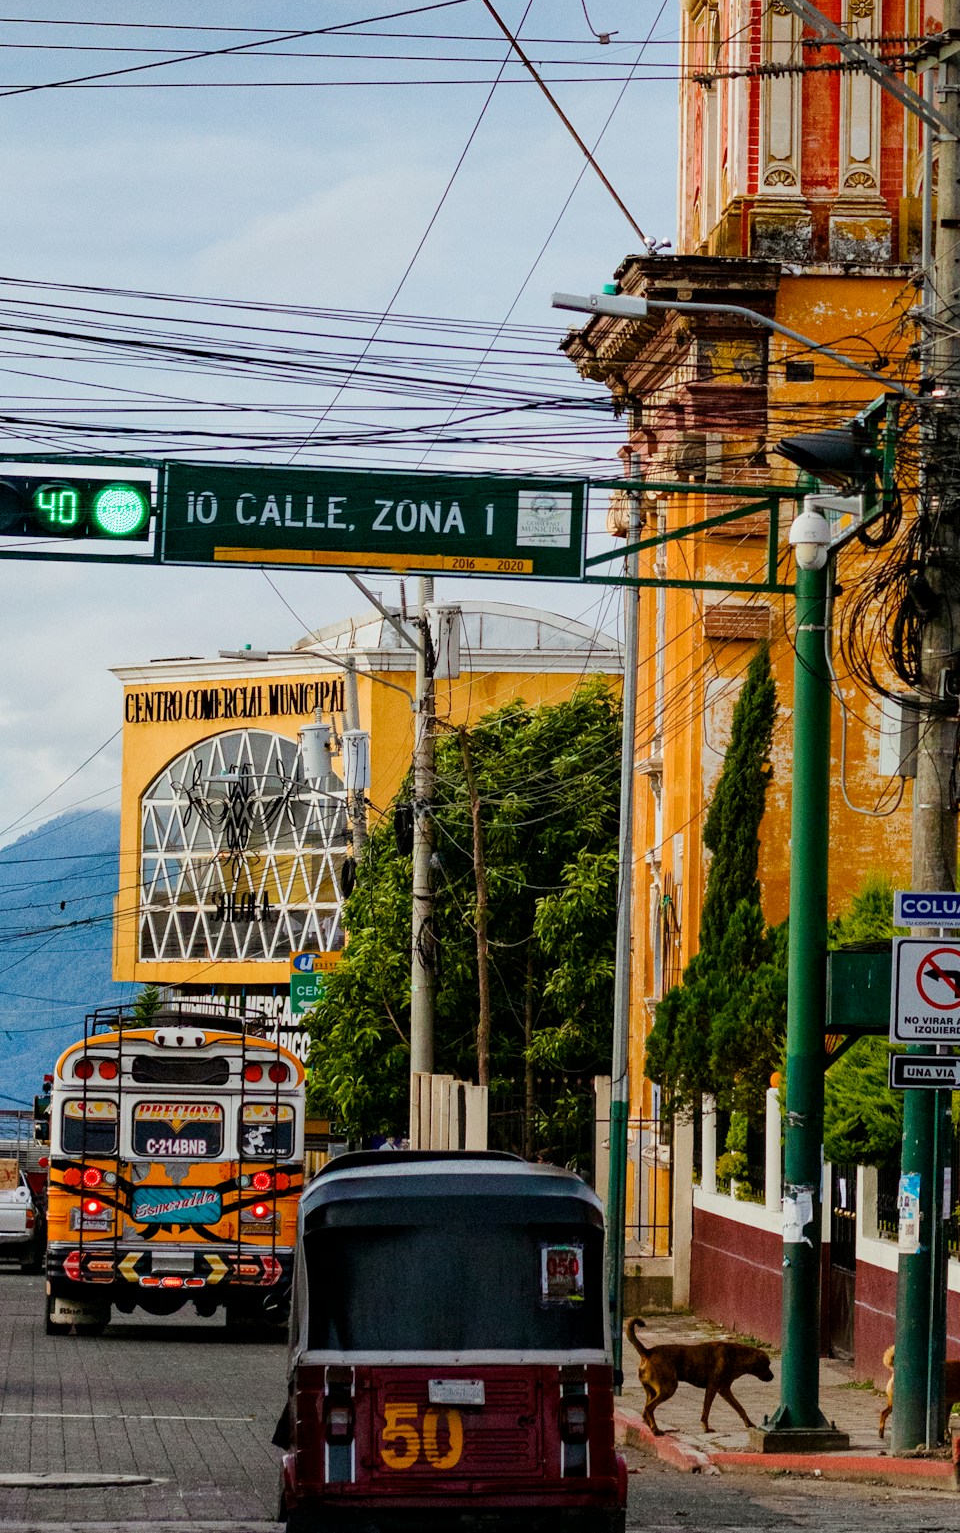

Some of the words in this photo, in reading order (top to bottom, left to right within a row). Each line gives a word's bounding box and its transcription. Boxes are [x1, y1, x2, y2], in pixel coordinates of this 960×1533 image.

[38, 490, 77, 524] 40
[187, 490, 218, 525] 10
[235, 492, 355, 532] CALLE,
[372, 499, 466, 535] ZONA
[485, 503, 494, 535] 1
[452, 558, 475, 569] 2016
[497, 560, 524, 571] 2020
[125, 689, 182, 723] CENTRO
[185, 685, 268, 720] COMERCIAL
[268, 680, 347, 715] MUNICIPAL
[904, 1016, 919, 1024] NO
[922, 1017, 953, 1025] VIRAR
[907, 1068, 931, 1077] UNA
[935, 1068, 955, 1077] VIA
[137, 1104, 221, 1118] PRECIOSA
[146, 1138, 207, 1154] C-214BNB
[134, 1189, 220, 1220] Esmeralda
[380, 1403, 464, 1469] 50
